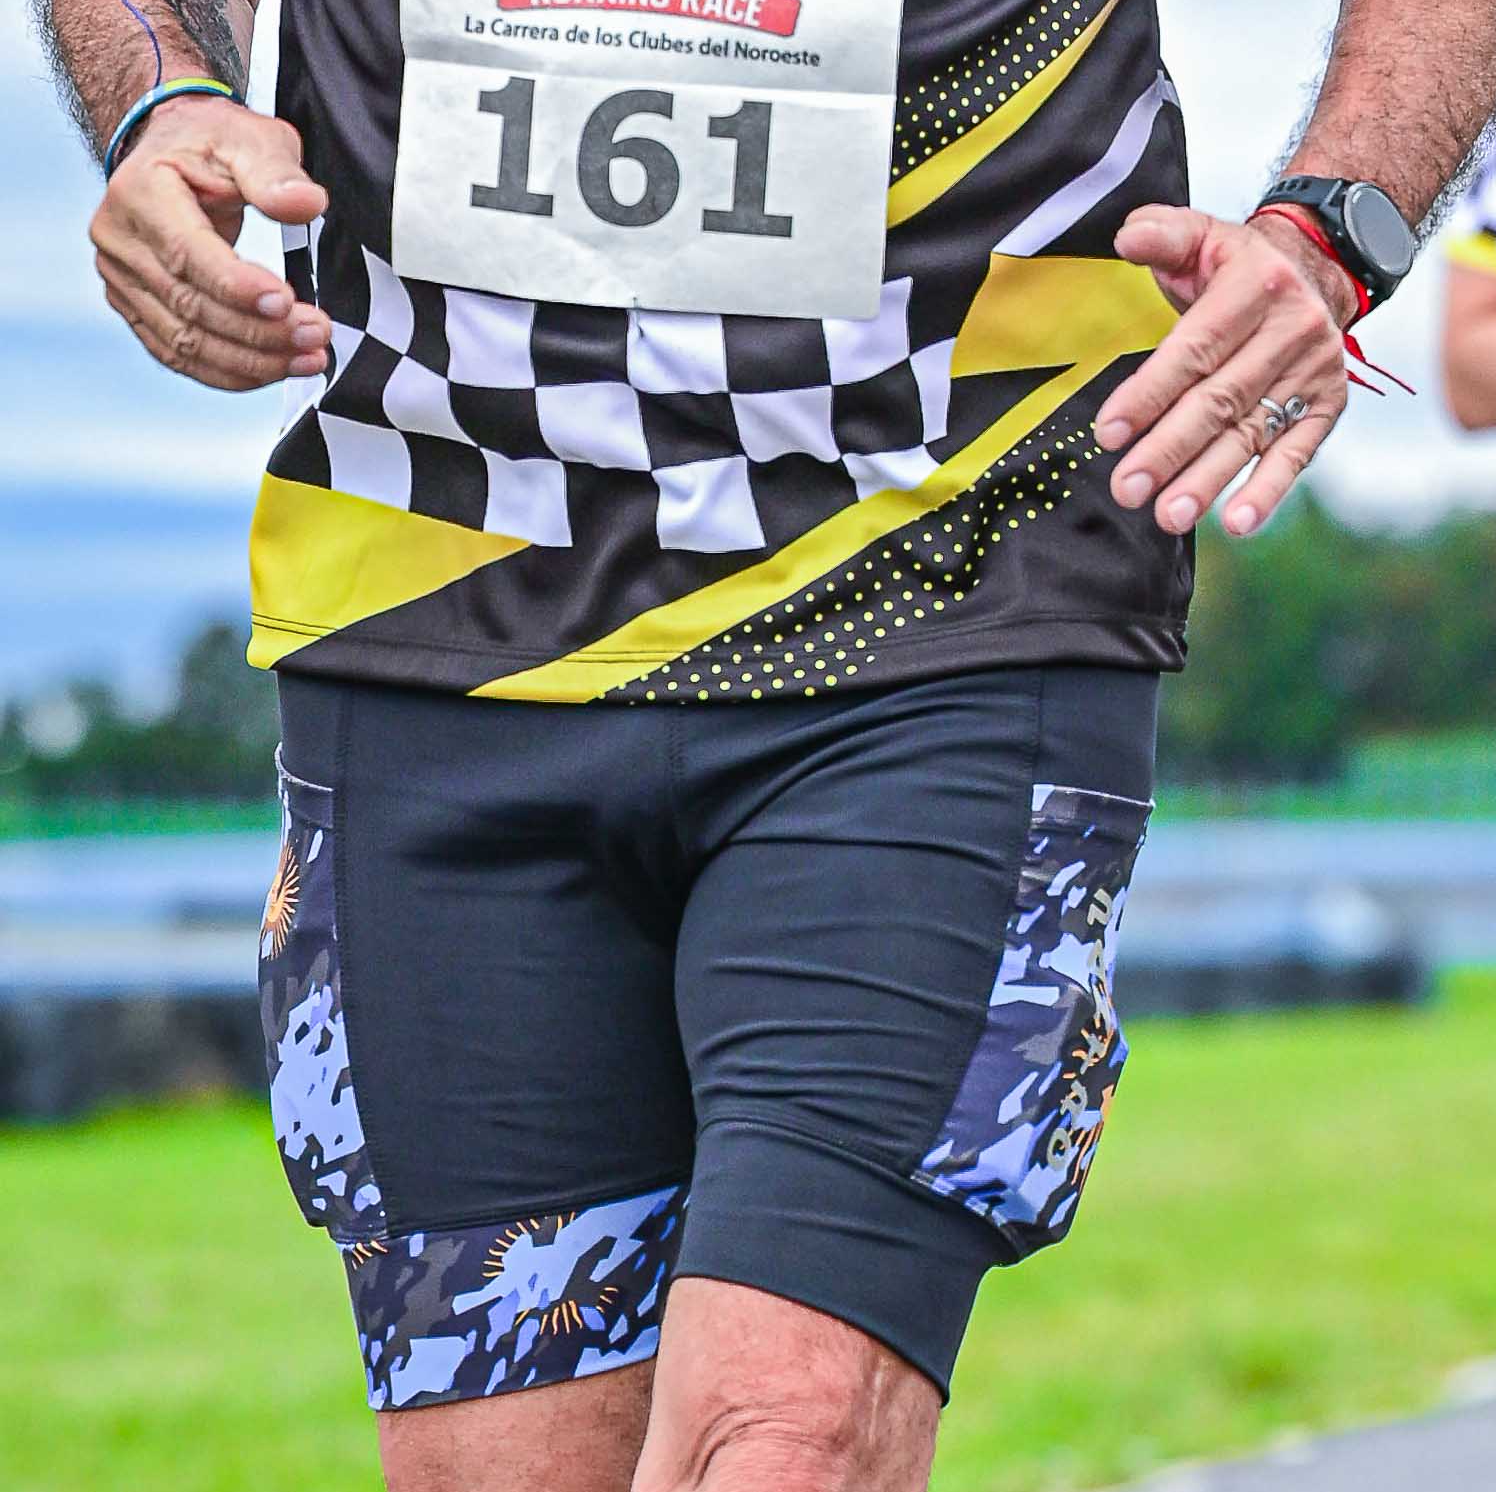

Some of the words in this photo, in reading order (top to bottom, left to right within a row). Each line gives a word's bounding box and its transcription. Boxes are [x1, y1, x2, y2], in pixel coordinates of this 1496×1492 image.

[463, 15, 485, 35] La
[490, 18, 560, 43] Carrera
[565, 23, 590, 45] de
[595, 26, 623, 48] los
[627, 30, 694, 56] Clubes
[699, 36, 730, 60] del
[734, 41, 822, 68] Noroeste
[469, 75, 794, 239] 161
